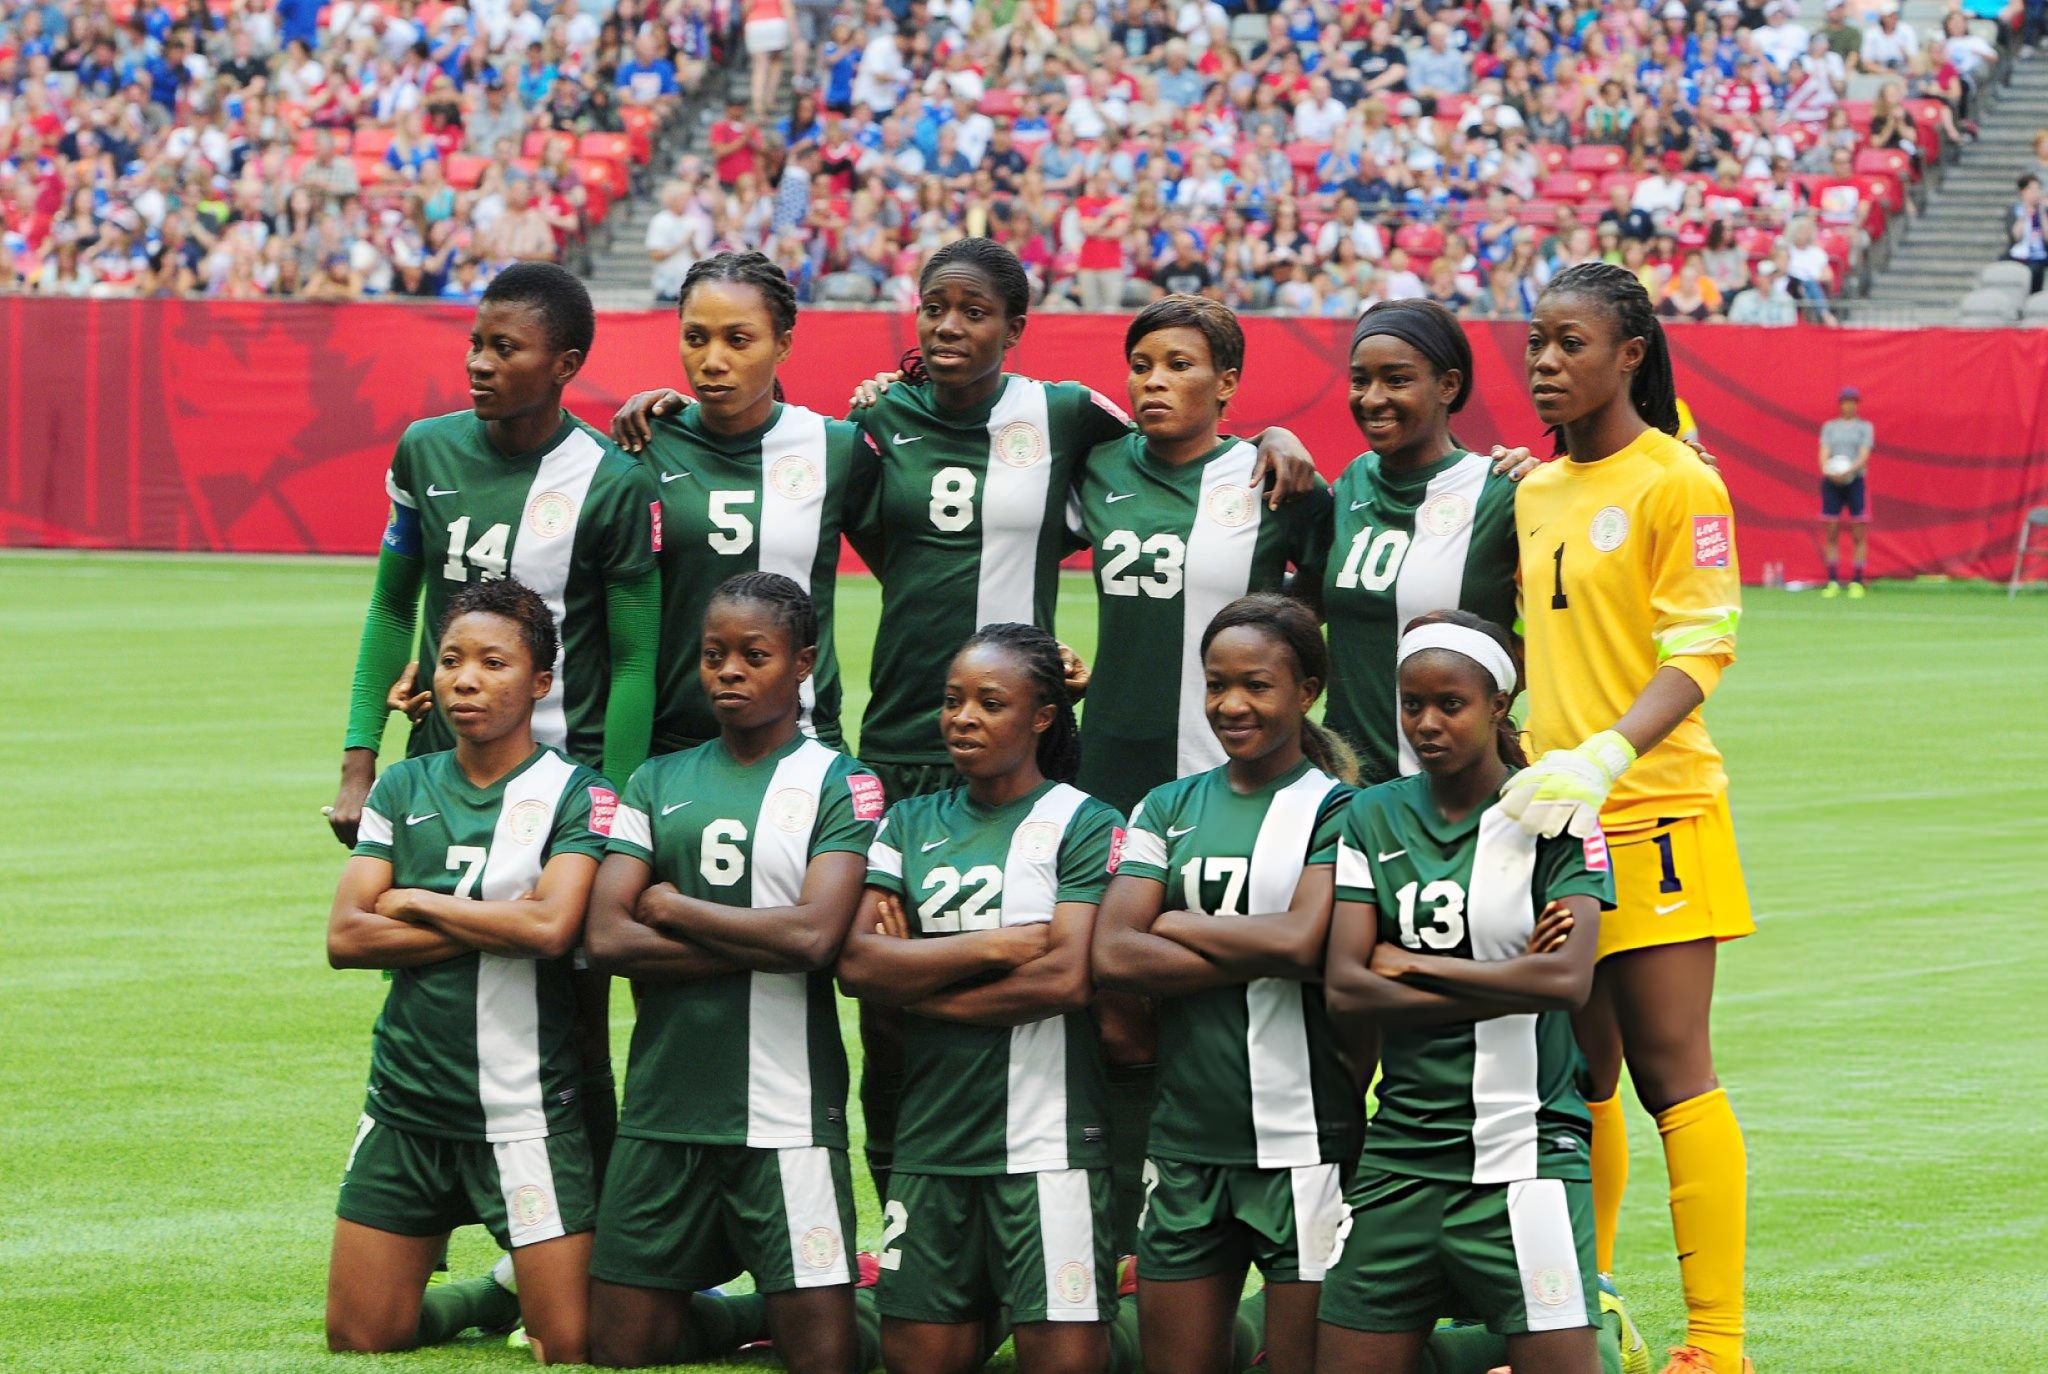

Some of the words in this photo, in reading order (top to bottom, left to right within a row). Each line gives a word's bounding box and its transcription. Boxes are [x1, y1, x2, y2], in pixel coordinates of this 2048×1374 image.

[708, 490, 755, 555] 5
[929, 466, 977, 532] 8
[444, 516, 511, 582] 14
[1101, 529, 1186, 599] 23
[1335, 526, 1410, 592] 10
[1551, 542, 1568, 610] 1
[445, 846, 487, 899] 7
[699, 818, 747, 886] 6
[1652, 832, 1682, 894] 1
[918, 865, 1003, 933] 22
[1181, 857, 1248, 916] 17
[1395, 880, 1465, 948] 13
